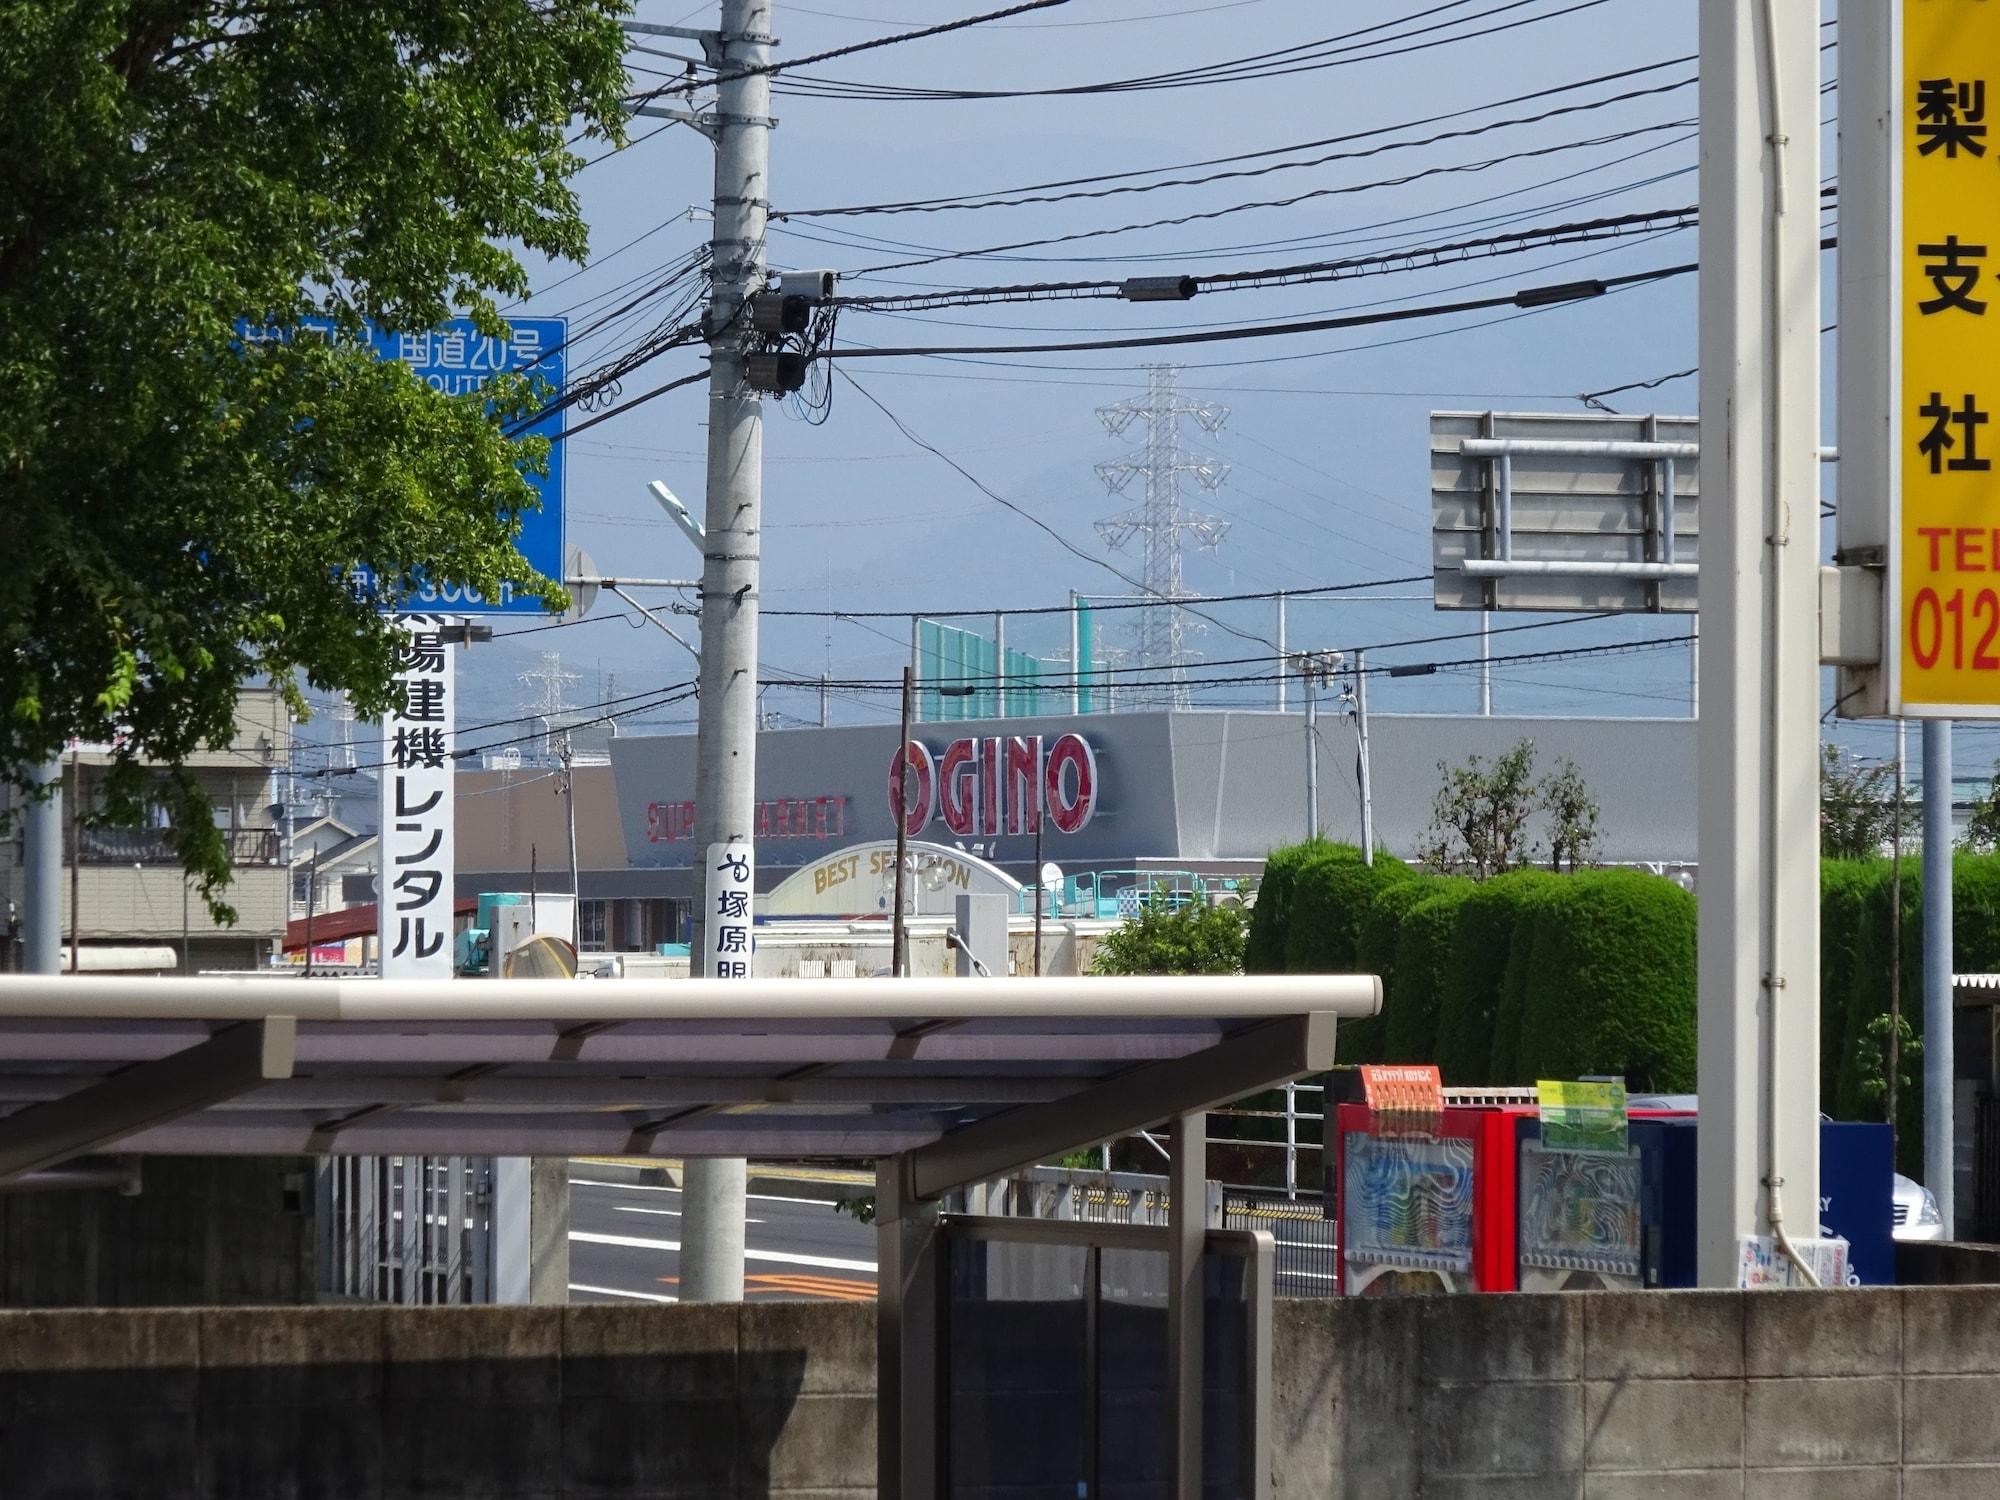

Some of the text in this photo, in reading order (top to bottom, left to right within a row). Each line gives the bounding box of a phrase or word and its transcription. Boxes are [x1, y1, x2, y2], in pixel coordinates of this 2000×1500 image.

[1916, 77, 1990, 474] 梨支社
[400, 328, 543, 371] 国道20号
[1910, 587, 2000, 670] 012
[390, 613, 446, 960] 陽建機レンタル
[887, 733, 1098, 837] OGINO
[813, 854, 861, 896] BEST
